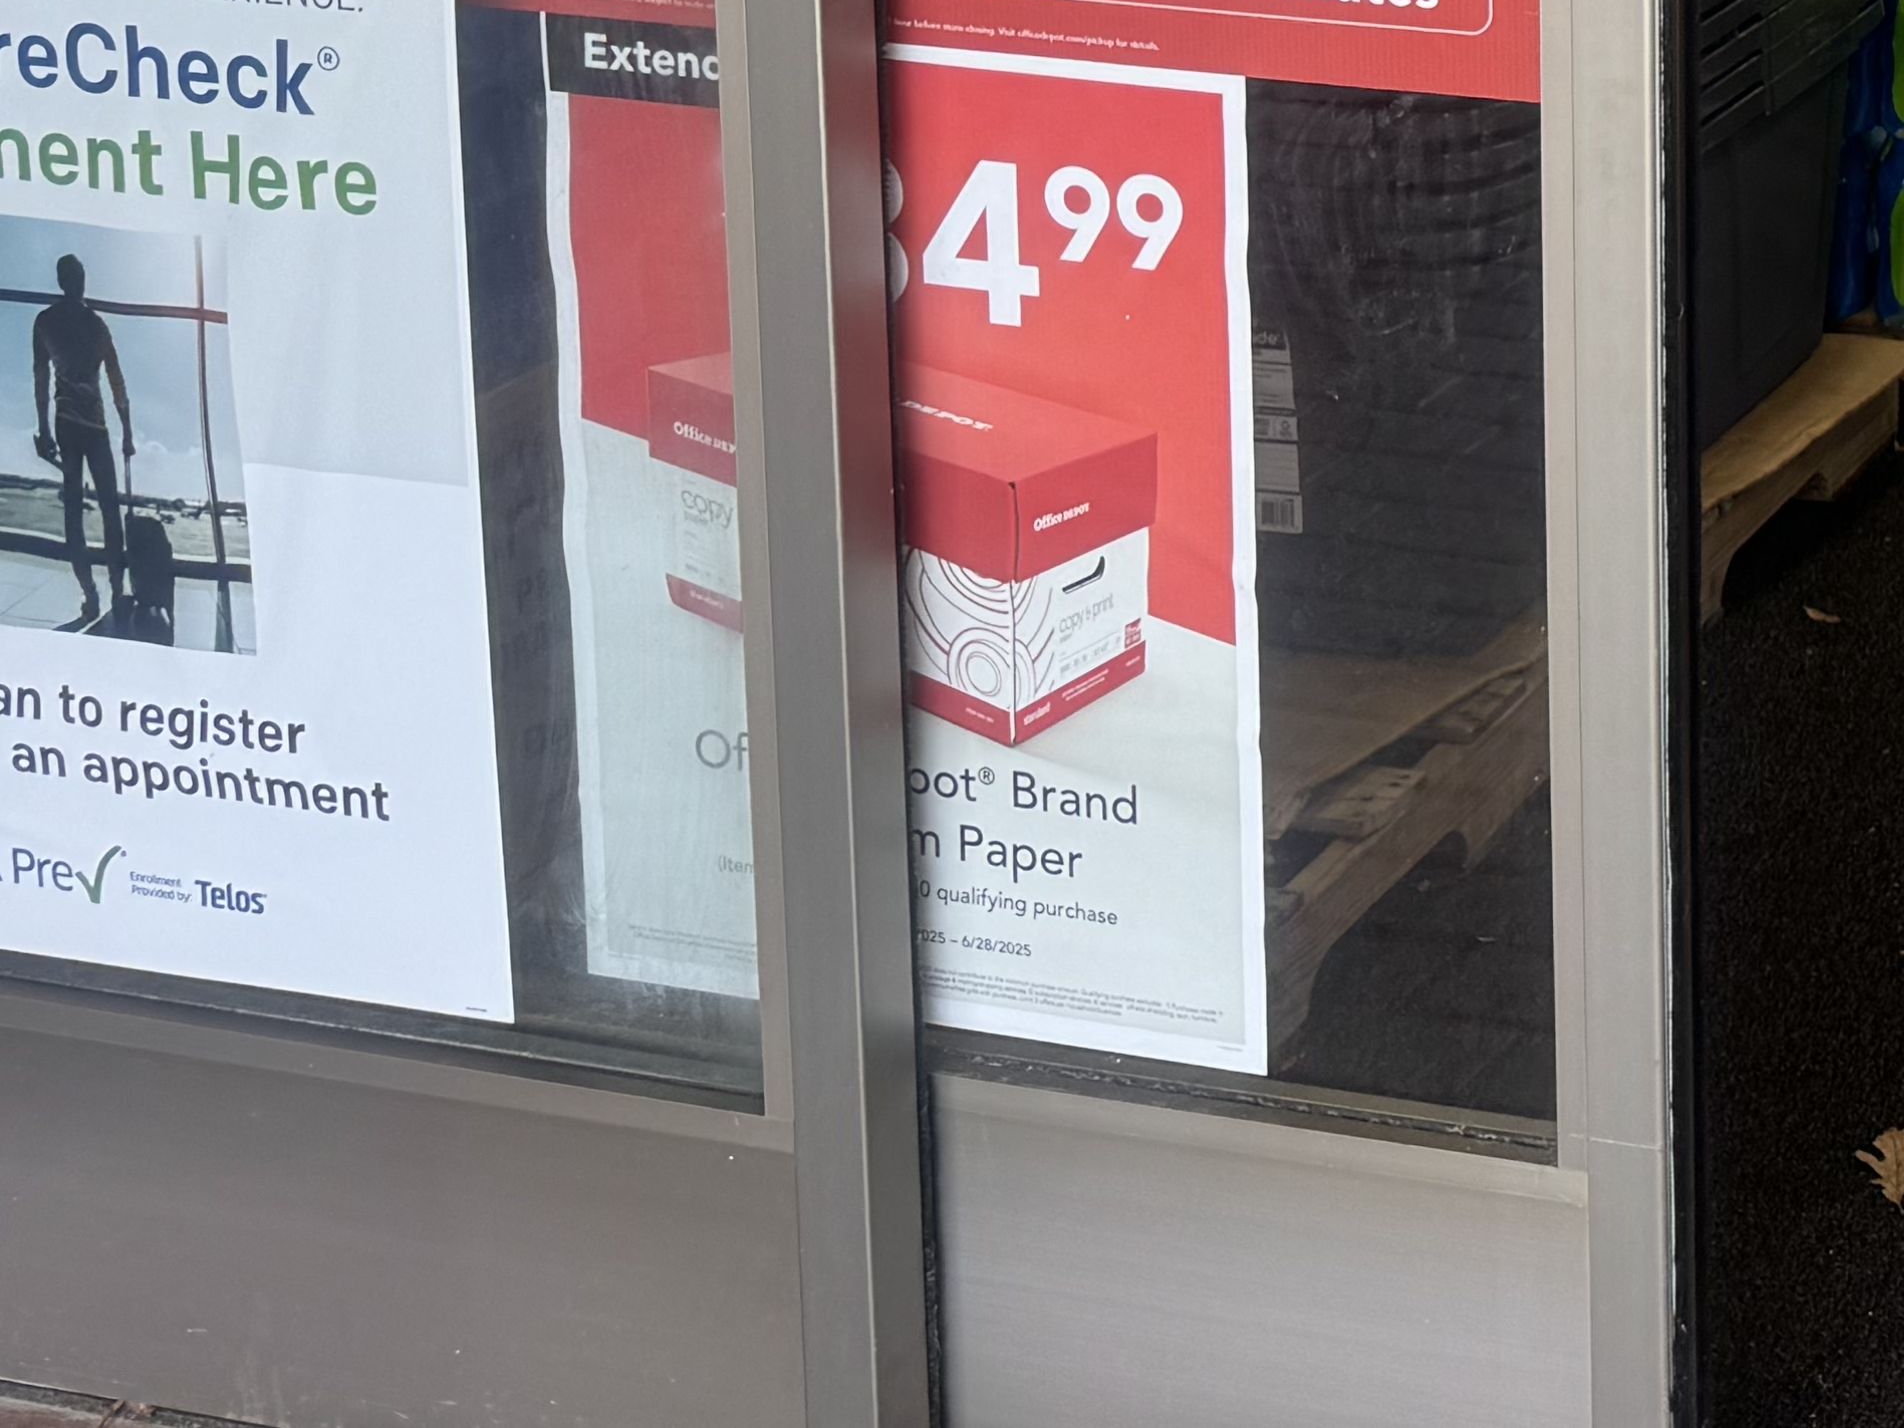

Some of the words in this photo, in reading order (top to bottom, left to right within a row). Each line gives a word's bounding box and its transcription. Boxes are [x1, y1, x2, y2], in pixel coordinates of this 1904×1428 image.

[189, 130, 379, 217] Here
[681, 489, 733, 530] copy
[1033, 512, 1063, 532] Office
[1058, 608, 1086, 635] copy
[1091, 594, 1115, 622] print
[58, 684, 102, 728] to
[119, 695, 306, 754] register
[12, 744, 66, 779] an
[82, 746, 391, 823] appointment
[1012, 769, 1140, 826] Brand
[959, 824, 1084, 885] Paper
[129, 871, 183, 889] Enrollment
[195, 878, 266, 915] Telos
[936, 887, 1027, 918] qualifying
[1033, 900, 1119, 926] purchase
[961, 934, 1033, 958] 6/28/2025
